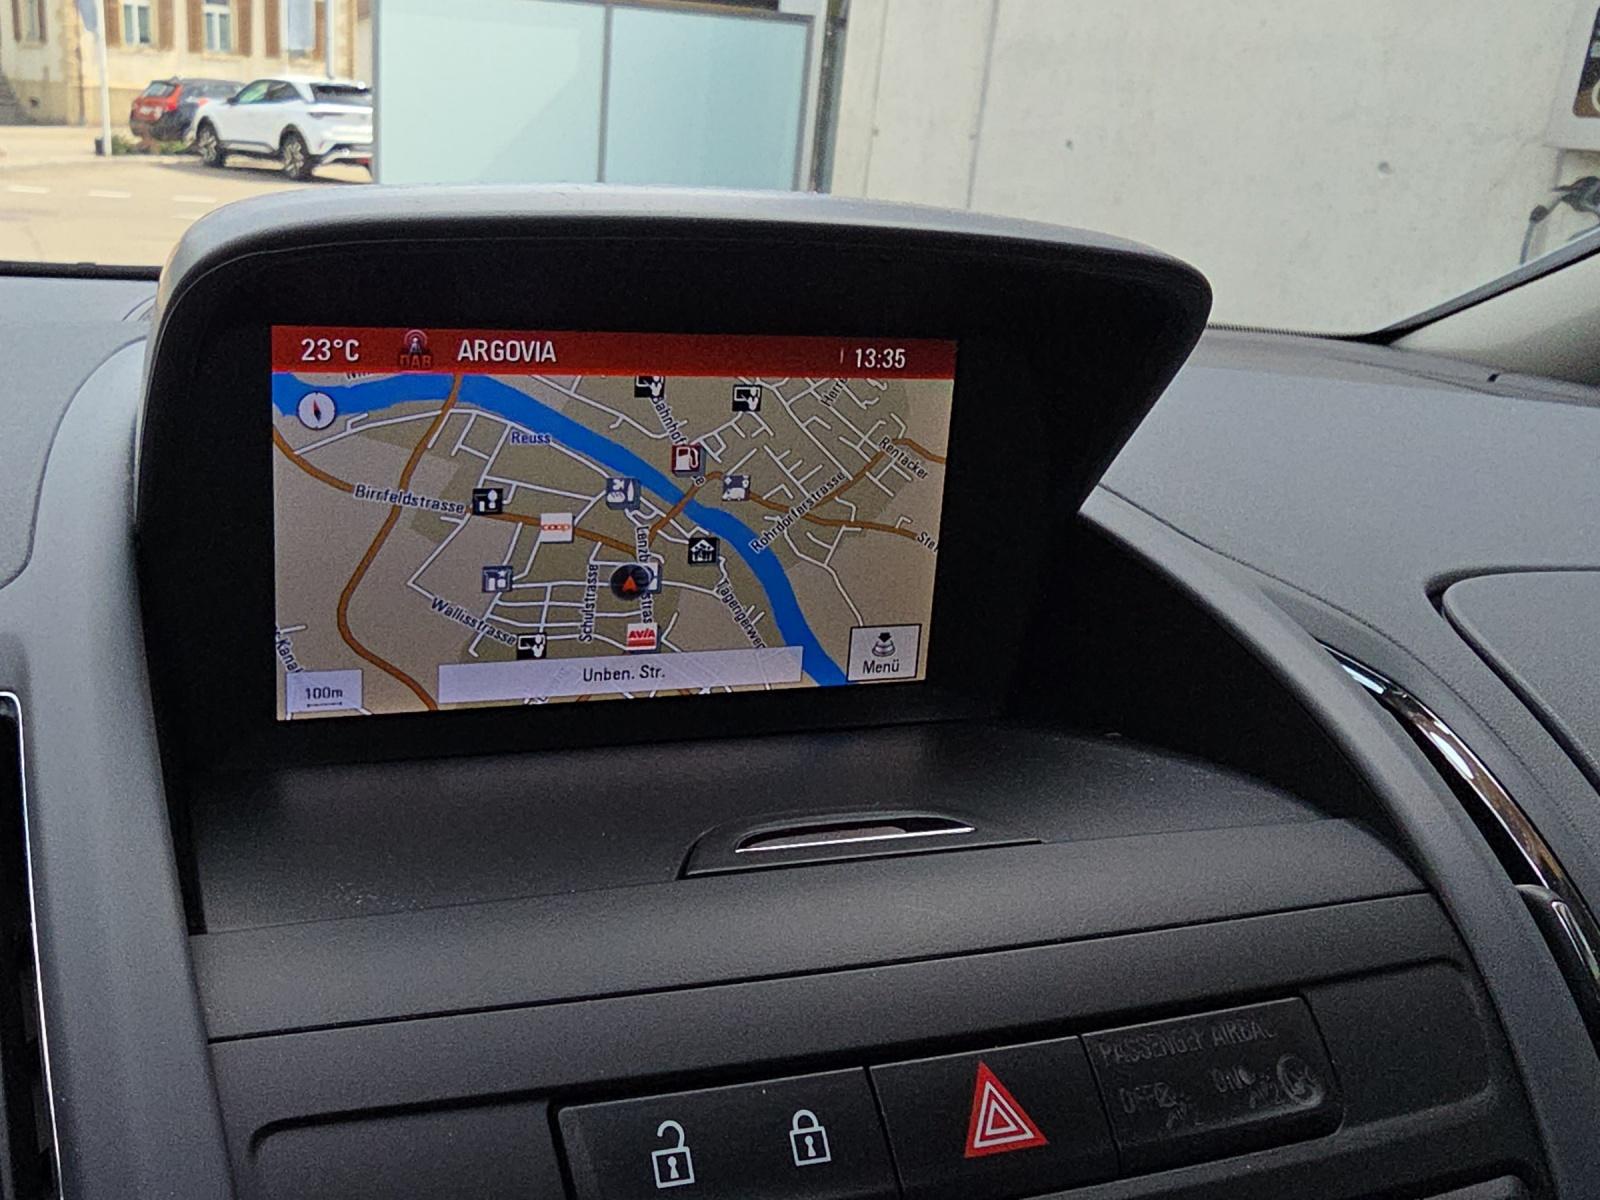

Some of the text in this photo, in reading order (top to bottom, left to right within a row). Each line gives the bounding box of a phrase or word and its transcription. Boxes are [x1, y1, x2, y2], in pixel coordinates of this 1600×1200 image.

[301, 338, 360, 363] 23°C
[399, 354, 432, 369] DAB
[457, 339, 557, 364] ARGOVIA
[854, 348, 906, 369] 13:35
[510, 431, 551, 445] Reuss
[879, 436, 928, 480] Rentacker
[354, 483, 465, 515] Birrfeldstrasse
[750, 472, 846, 553] Rohrdorferstrasse
[578, 563, 598, 642] Schulstrasse
[430, 596, 517, 647] Wallisstrasse
[628, 628, 656, 639] AVIA
[582, 664, 666, 683] Unben. Str.
[862, 658, 900, 675] Menü
[305, 686, 344, 700] 100m
